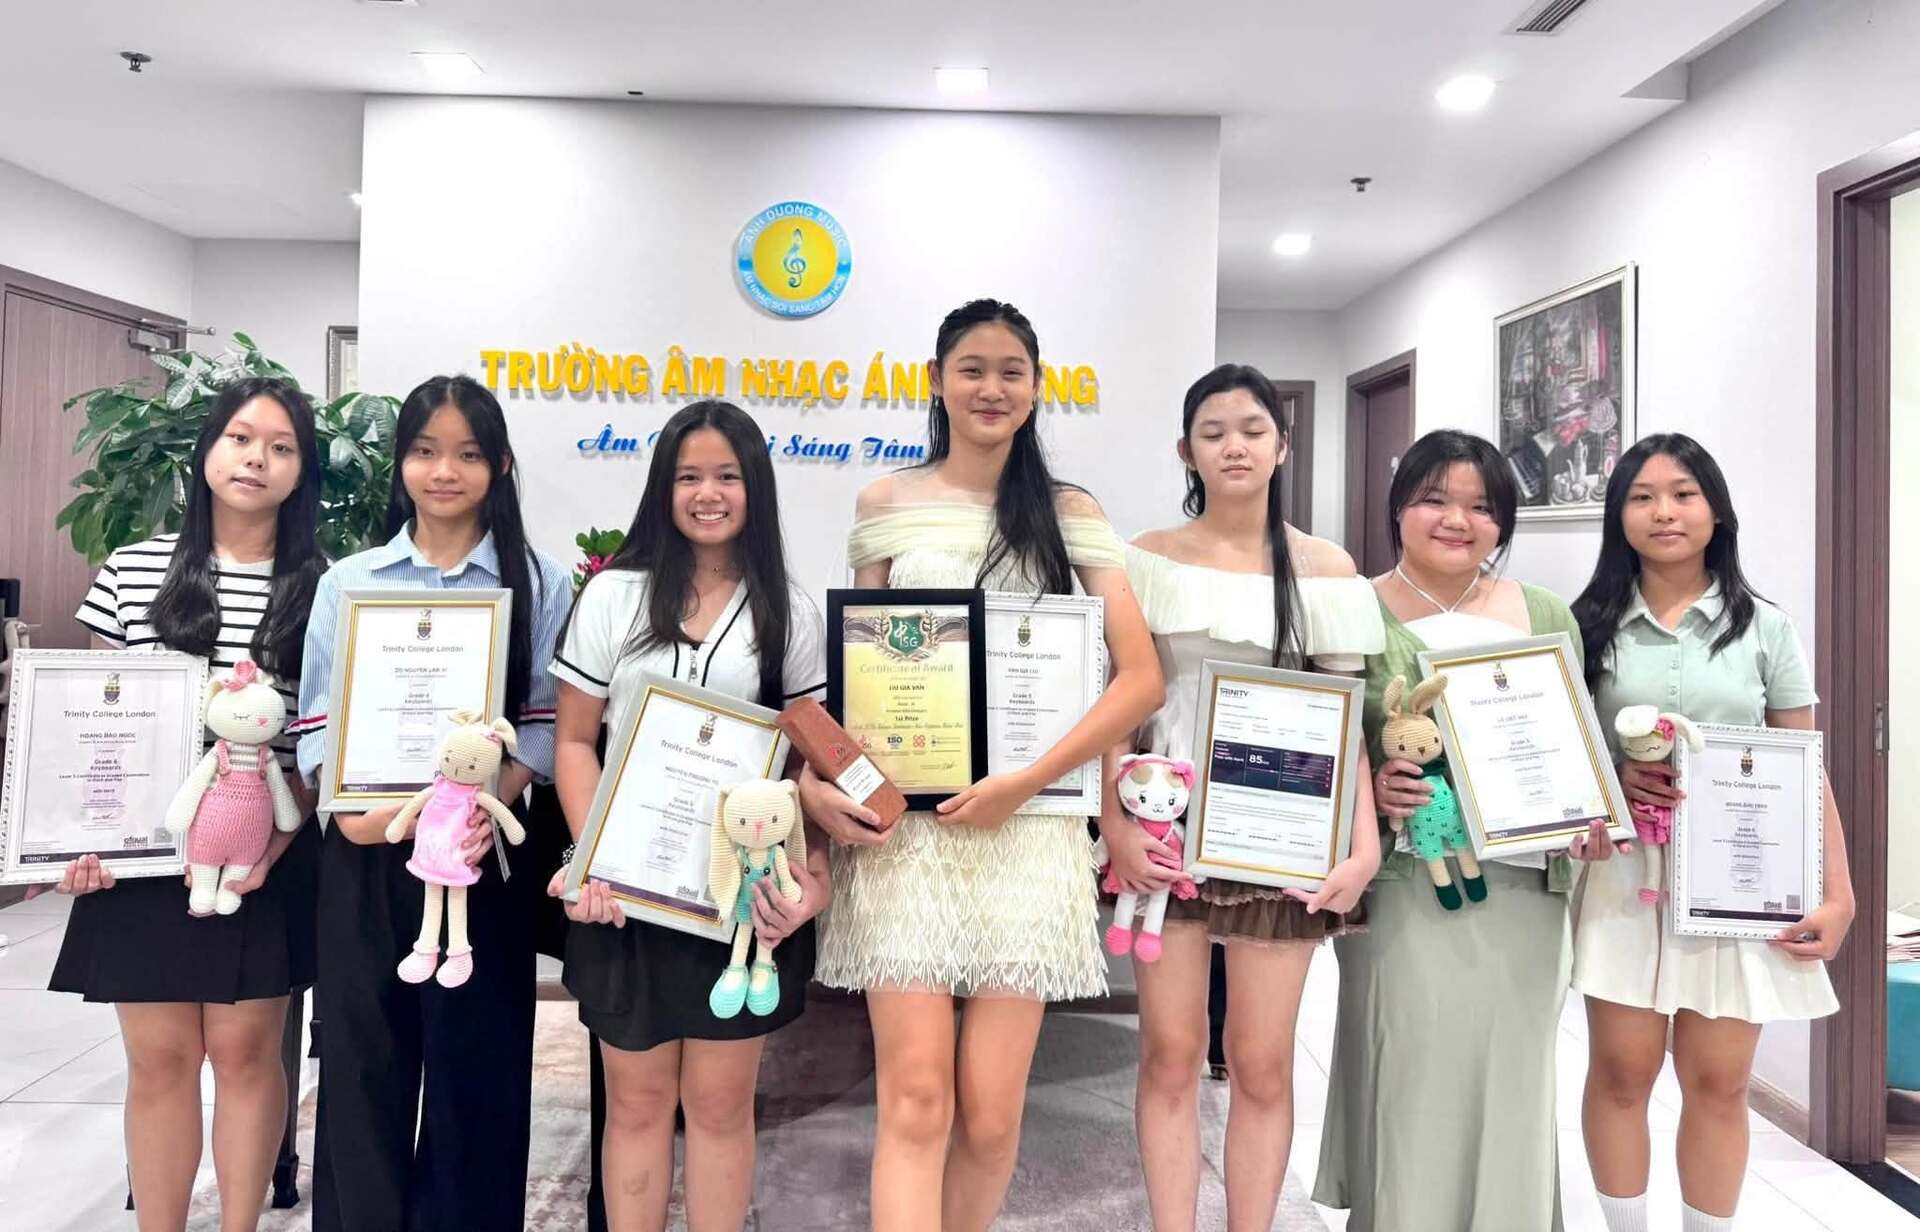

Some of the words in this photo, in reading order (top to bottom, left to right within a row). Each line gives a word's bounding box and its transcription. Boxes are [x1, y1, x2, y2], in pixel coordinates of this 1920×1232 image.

[480, 342, 649, 394] TRƯỜNG
[662, 345, 726, 397] ÂM
[742, 358, 849, 408] NHẠC
[577, 423, 637, 451] Âm
[783, 434, 851, 461] Sáng
[1220, 687, 1249, 697] TRINITY
[64, 710, 90, 719] Trinity
[92, 710, 124, 719] College
[125, 710, 156, 718] London
[1248, 754, 1263, 764] 85
